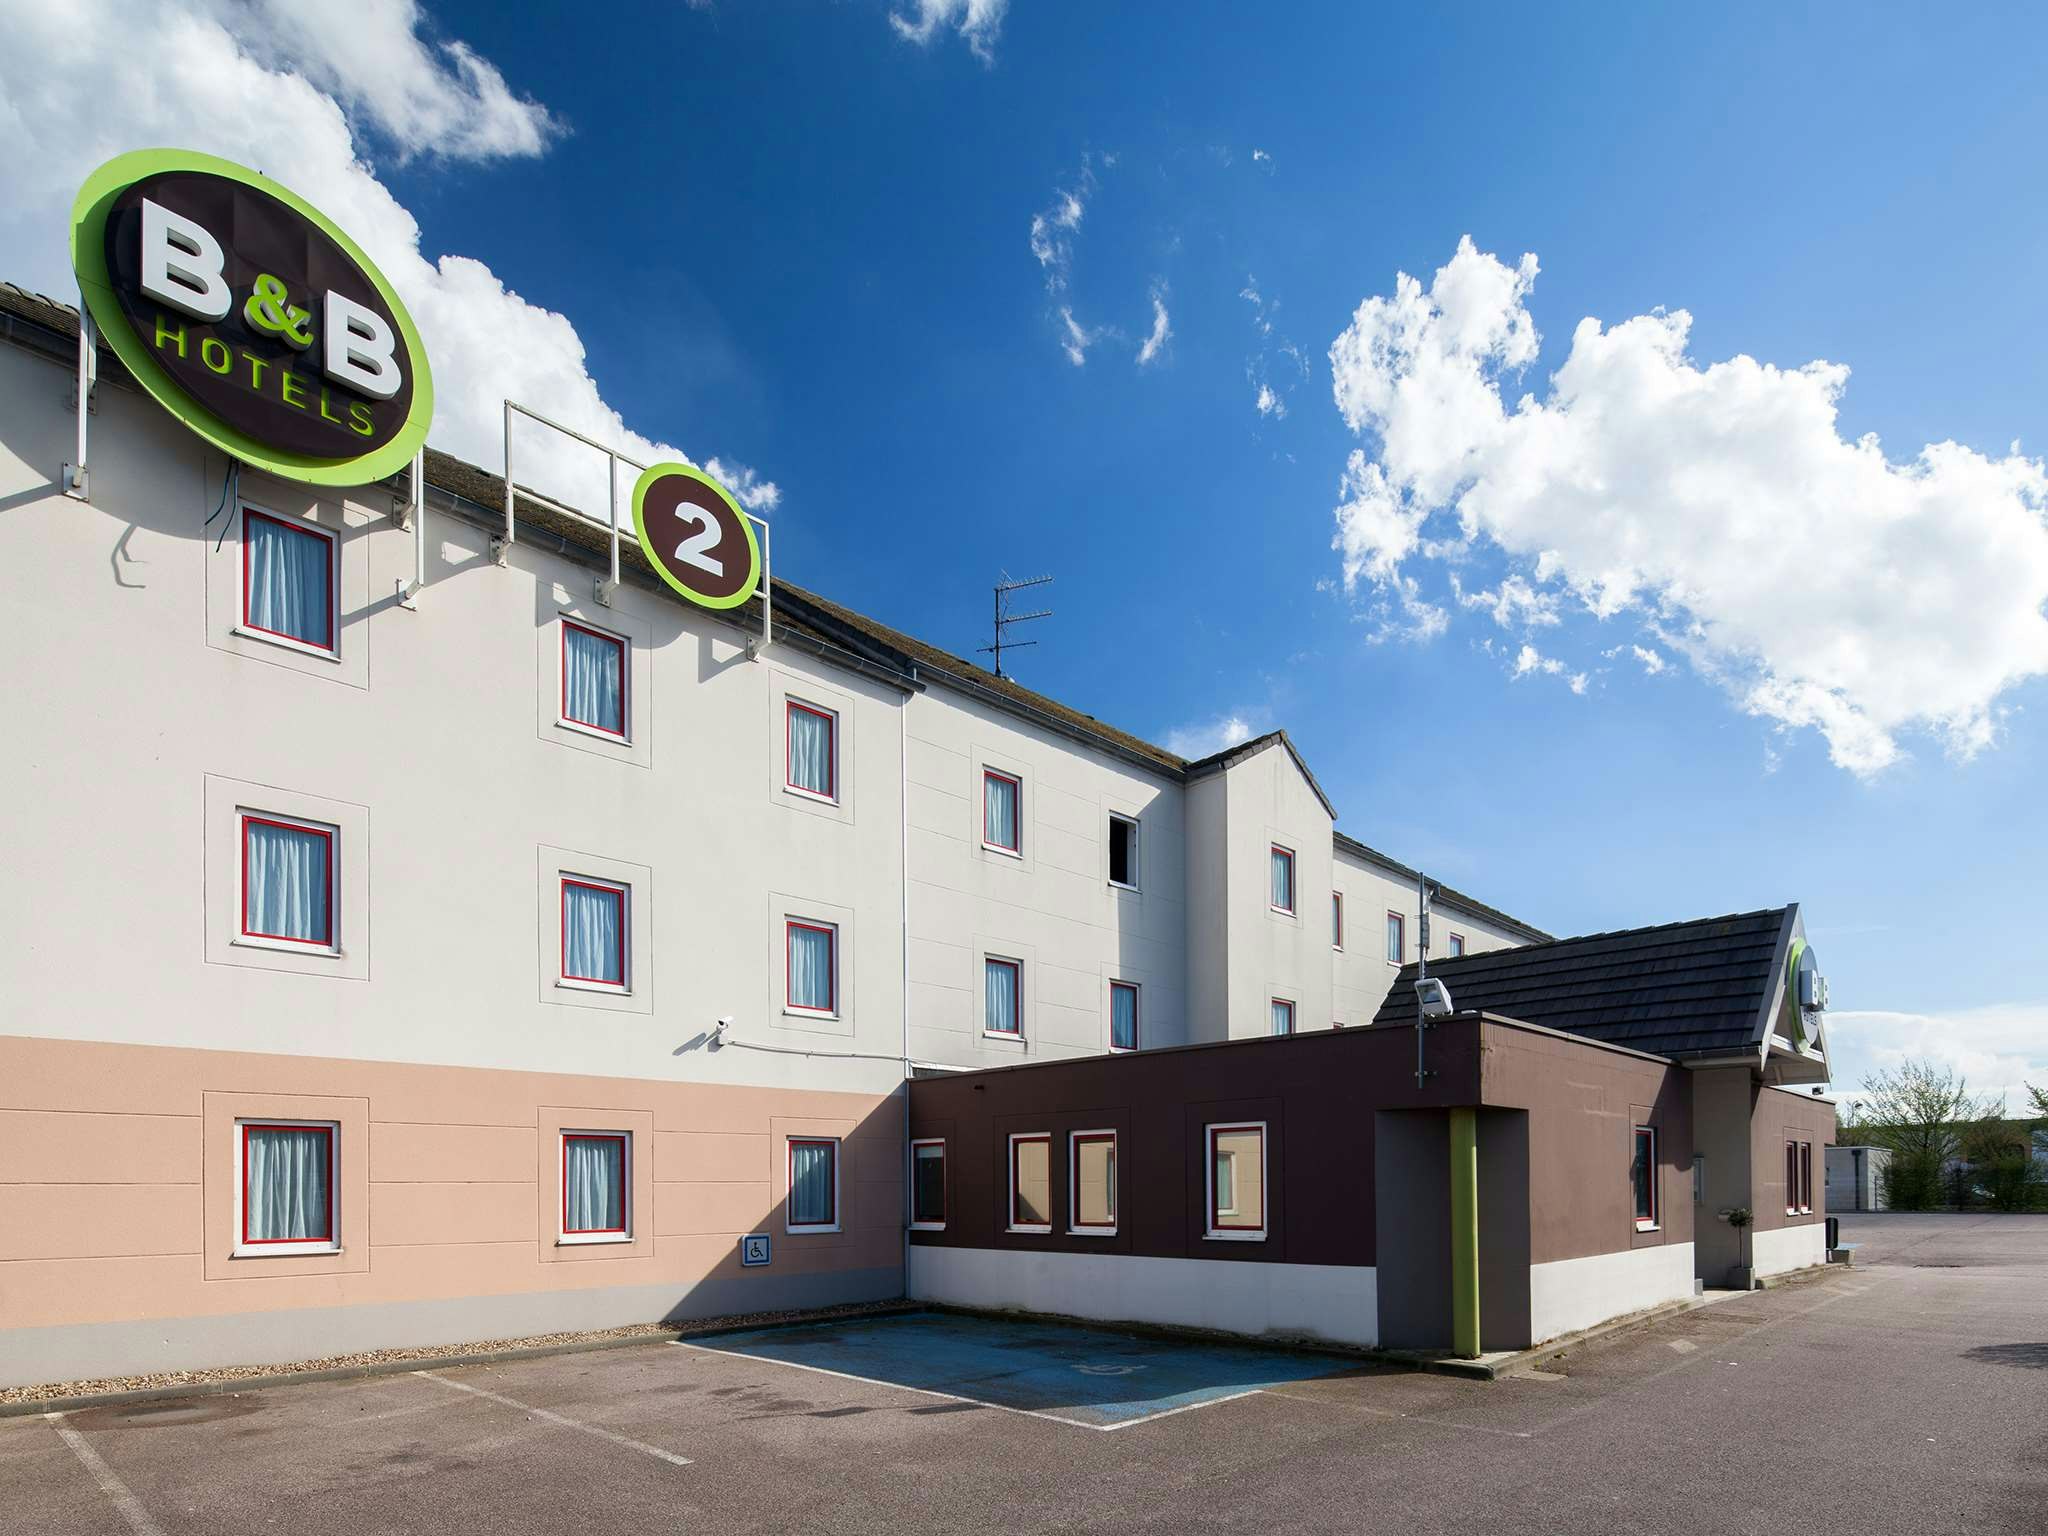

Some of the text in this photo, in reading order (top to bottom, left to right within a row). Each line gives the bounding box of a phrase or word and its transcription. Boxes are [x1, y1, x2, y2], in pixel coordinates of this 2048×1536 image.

[141, 197, 402, 400] B&B
[153, 312, 376, 437] HOTELS
[674, 501, 723, 578] 2
